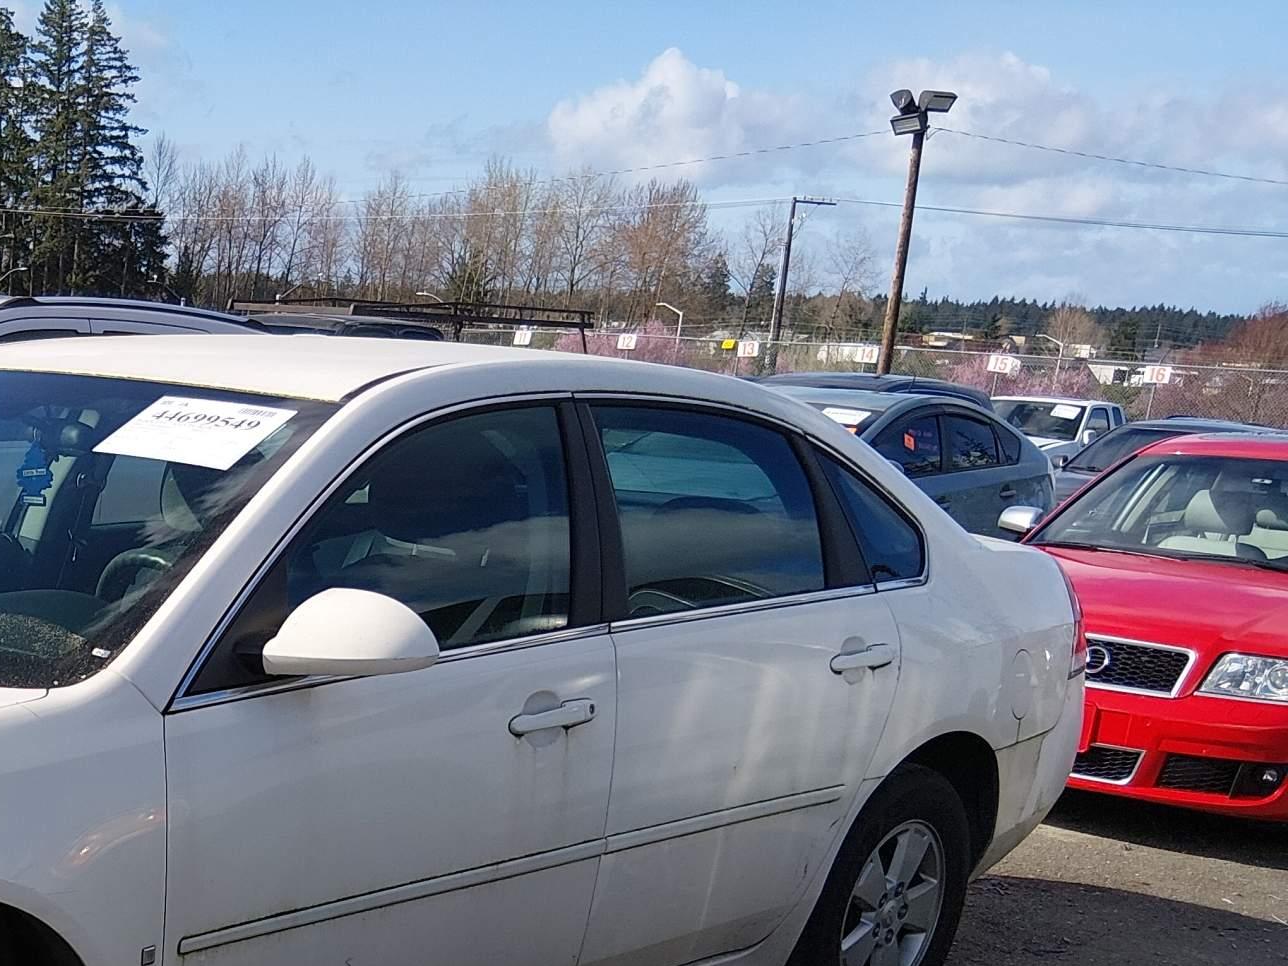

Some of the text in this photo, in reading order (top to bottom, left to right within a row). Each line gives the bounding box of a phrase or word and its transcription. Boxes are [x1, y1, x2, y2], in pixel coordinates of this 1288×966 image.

[622, 336, 633, 347] 12
[742, 342, 754, 355] 13
[862, 348, 873, 361] 14
[994, 357, 1009, 371] 15
[1149, 367, 1165, 381] 16
[152, 410, 261, 430] 44699549
